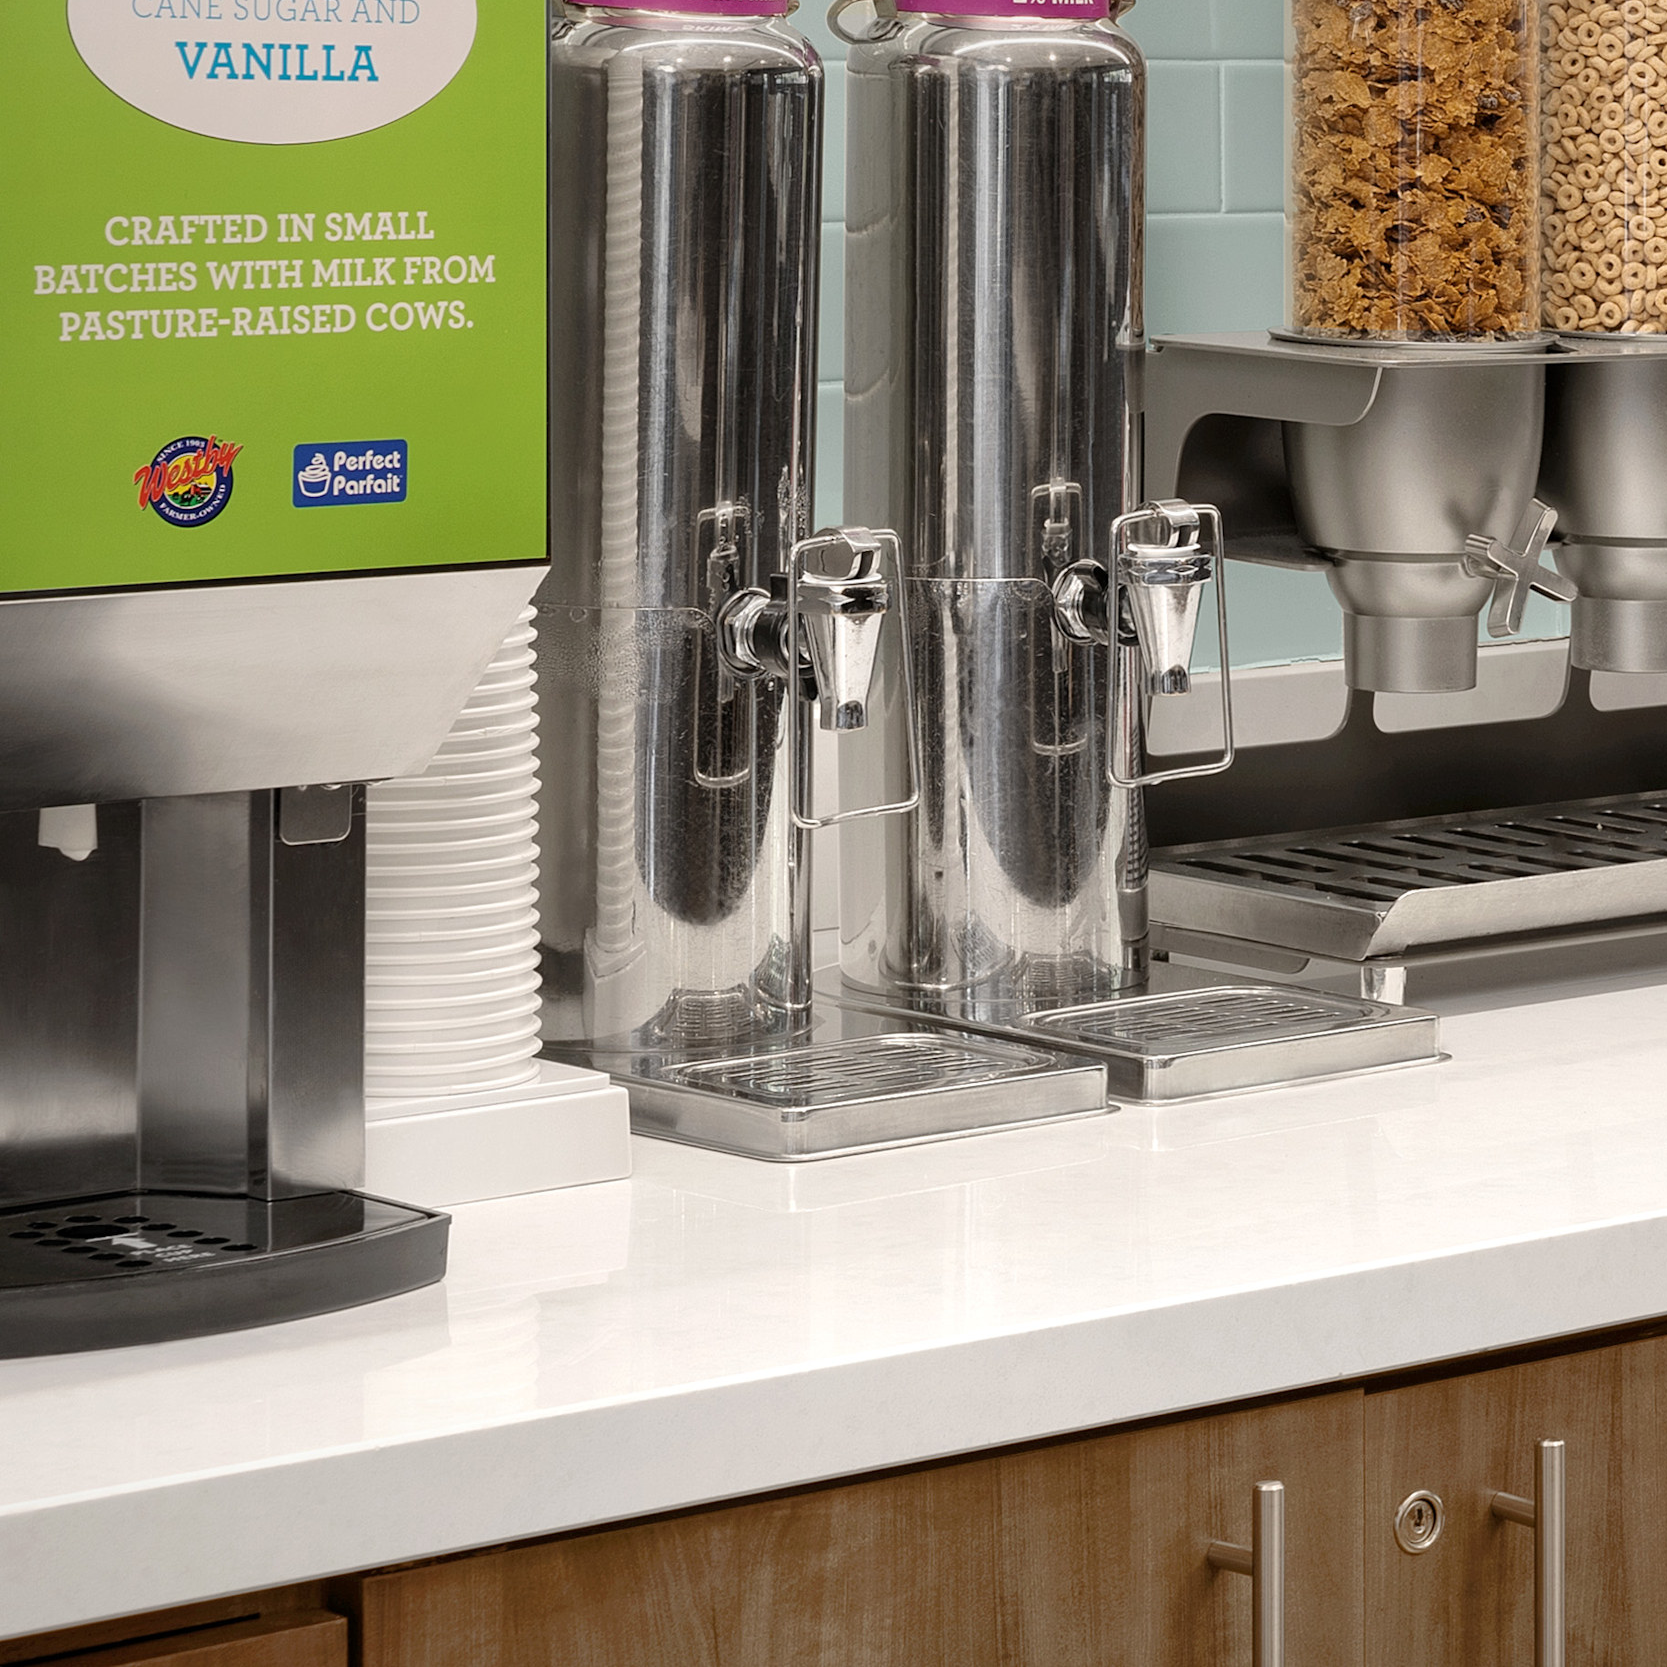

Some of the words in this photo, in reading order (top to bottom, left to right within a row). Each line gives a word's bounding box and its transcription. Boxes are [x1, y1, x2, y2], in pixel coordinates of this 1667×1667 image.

[175, 42, 379, 82] VANILLA
[104, 214, 268, 246] CRAFTED
[276, 213, 315, 242] IN
[324, 210, 434, 241] SMALL
[33, 262, 197, 296] BATCHES
[206, 259, 303, 290] WITH
[311, 257, 396, 287] MILK
[403, 254, 496, 285] FROM
[58, 304, 356, 341] PASTURE-RAISED
[365, 301, 474, 332] COWS.
[156, 440, 184, 462] SINCE
[333, 449, 401, 472] Perfect
[133, 434, 244, 511] Westby
[333, 472, 401, 496] Parfait
[159, 484, 226, 521] FARMER-OWNED
